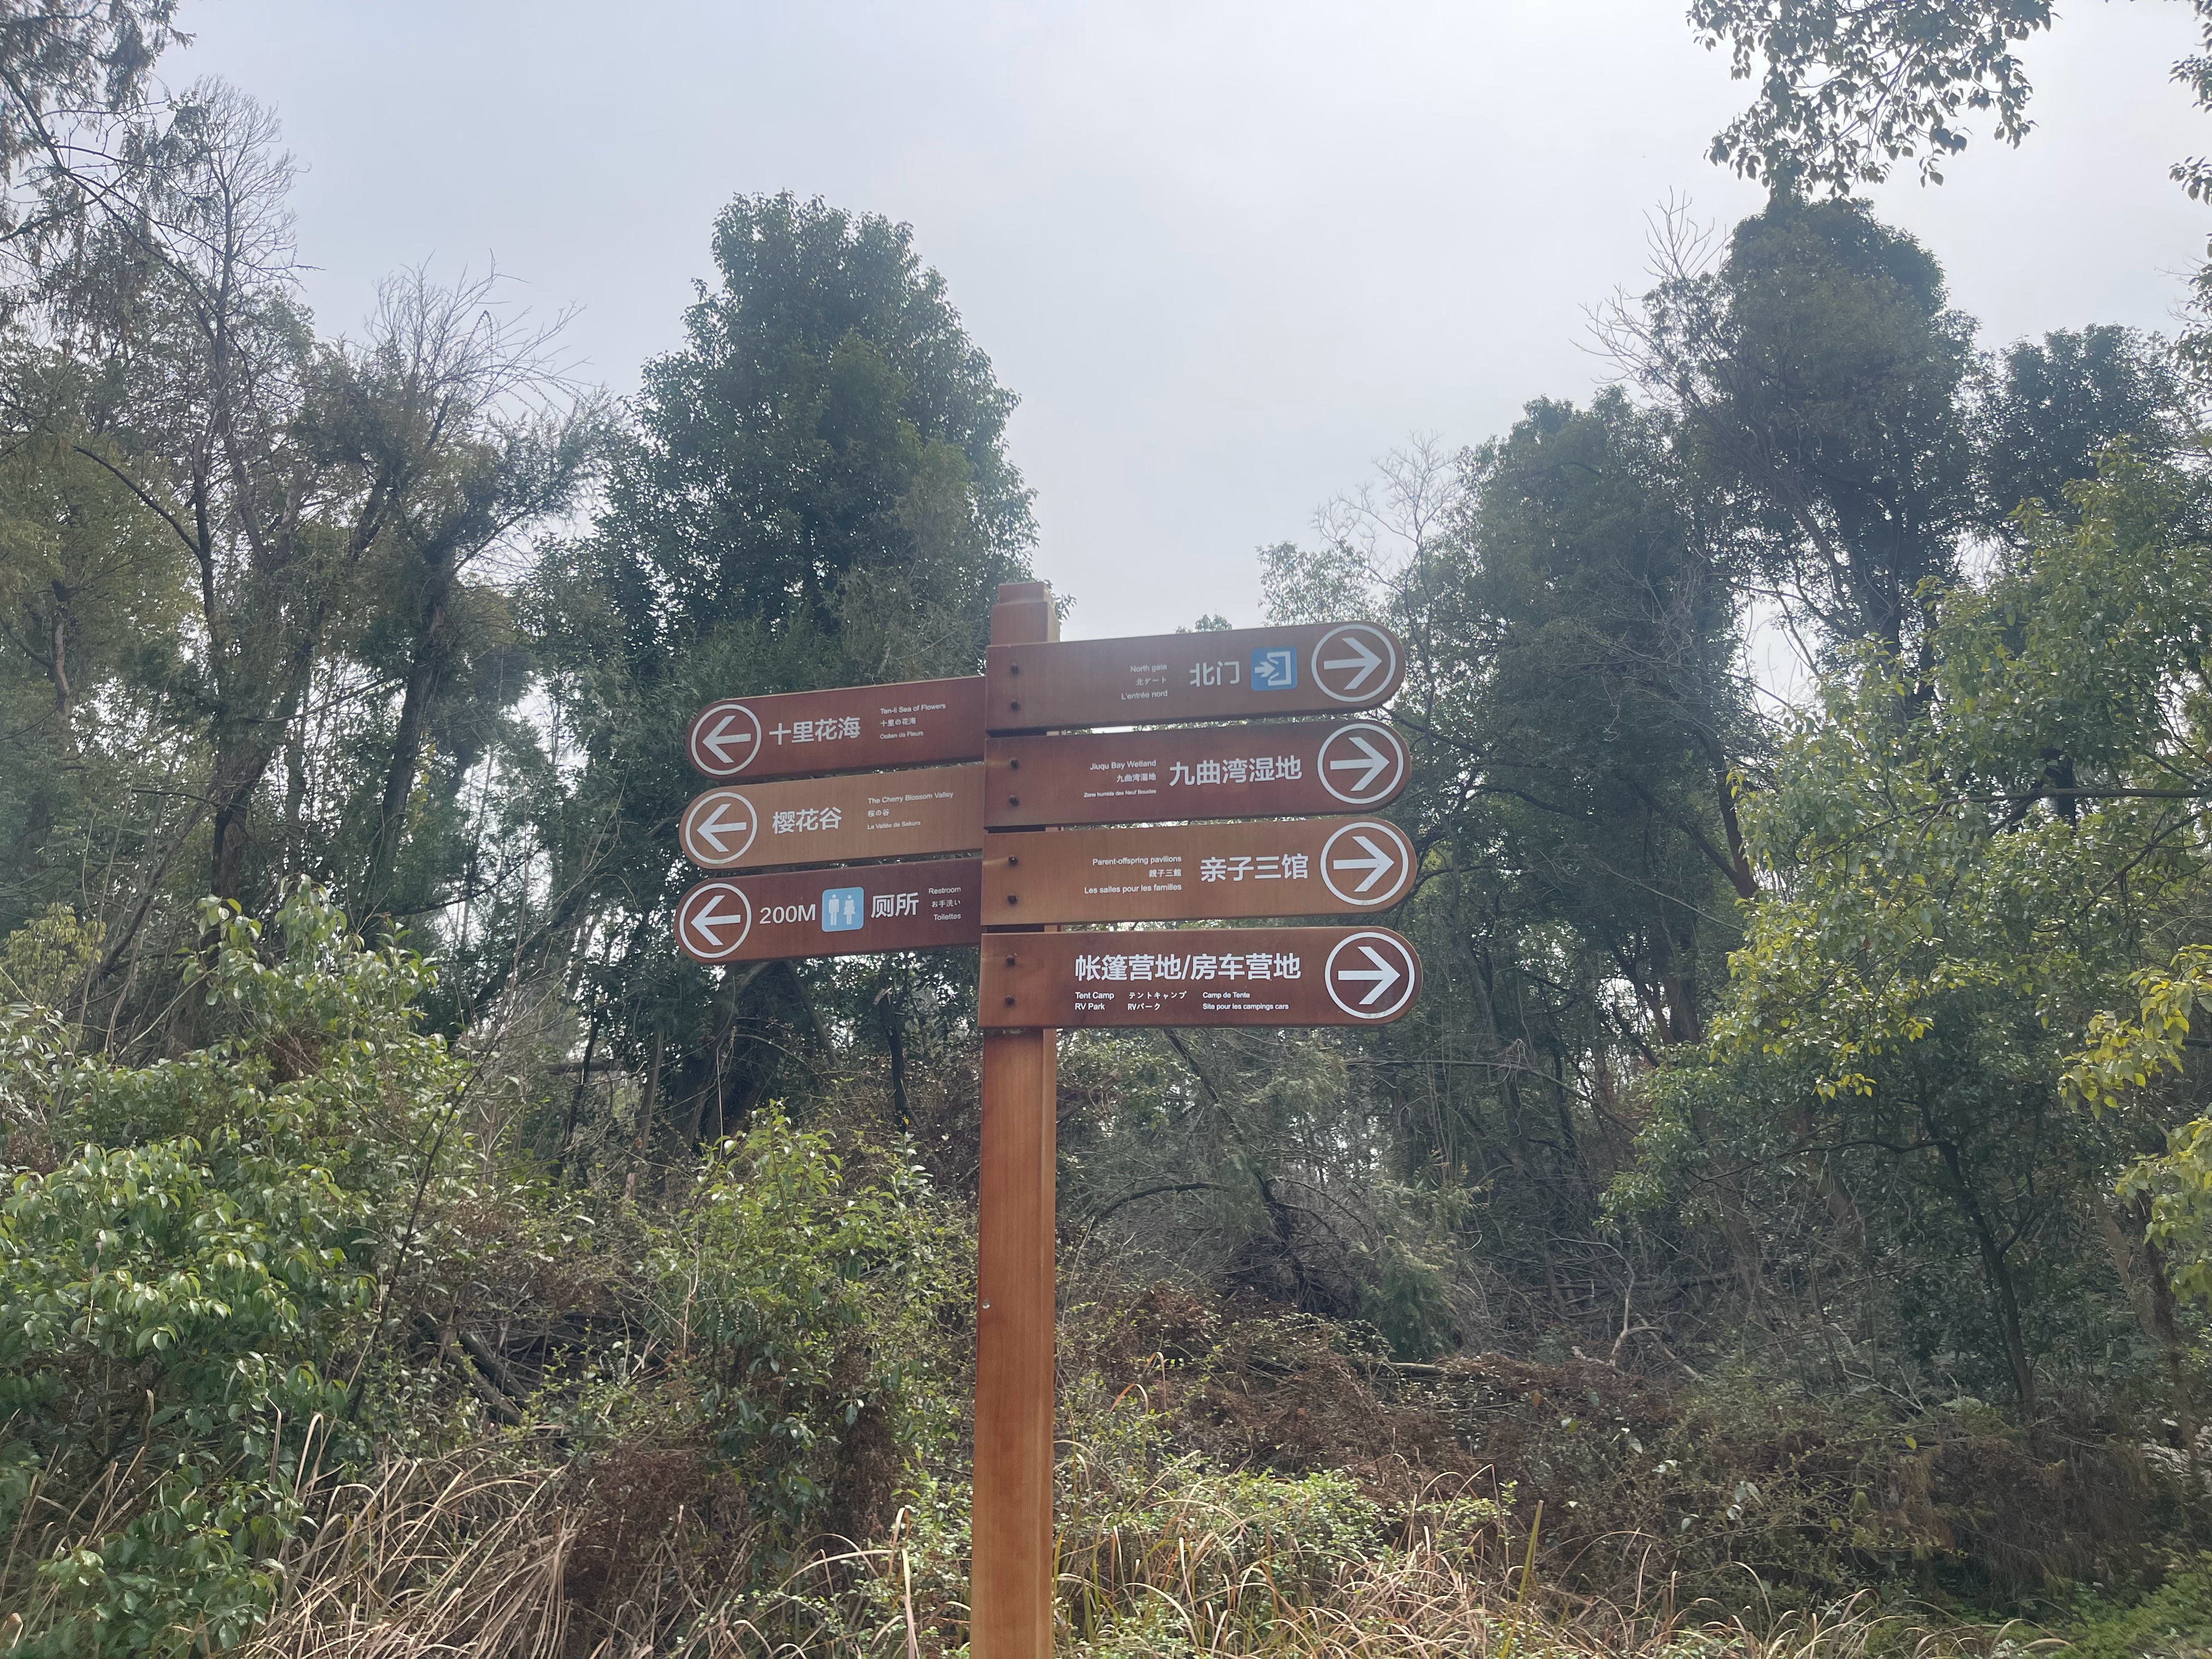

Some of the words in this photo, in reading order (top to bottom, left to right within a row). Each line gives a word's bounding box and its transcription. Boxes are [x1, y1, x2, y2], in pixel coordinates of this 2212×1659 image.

[1152, 664, 1167, 673] gate
[1189, 661, 1240, 687] 北门
[1121, 692, 1150, 700] L'entrée
[1152, 690, 1168, 698] nord
[769, 716, 861, 745] 十里花海
[1090, 763, 1109, 771] Jiuqu
[1111, 761, 1125, 770] Bay
[1126, 759, 1156, 768] Wetland
[1169, 755, 1302, 787] 九曲湾湿地
[905, 793, 933, 802] Blossom
[934, 791, 954, 799] Valley
[772, 807, 842, 834] 樱花谷
[1092, 857, 1149, 866] Parent-offspring
[1150, 855, 1182, 865] pavilions
[1200, 853, 1309, 883] 亲子三馆
[1122, 886, 1139, 894] pour
[1154, 883, 1182, 891] familles
[871, 892, 919, 919] 厕所
[932, 900, 961, 908] お手洗い
[759, 904, 816, 925] 200M
[933, 913, 962, 921] Toilettes
[1075, 953, 1302, 981] 帐篷营地/房车营地
[1092, 991, 1115, 1001] Camp
[1128, 990, 1188, 1000] テントキャンプ
[1127, 1002, 1161, 1011] RVパーク
[1243, 1003, 1274, 1011] campings
